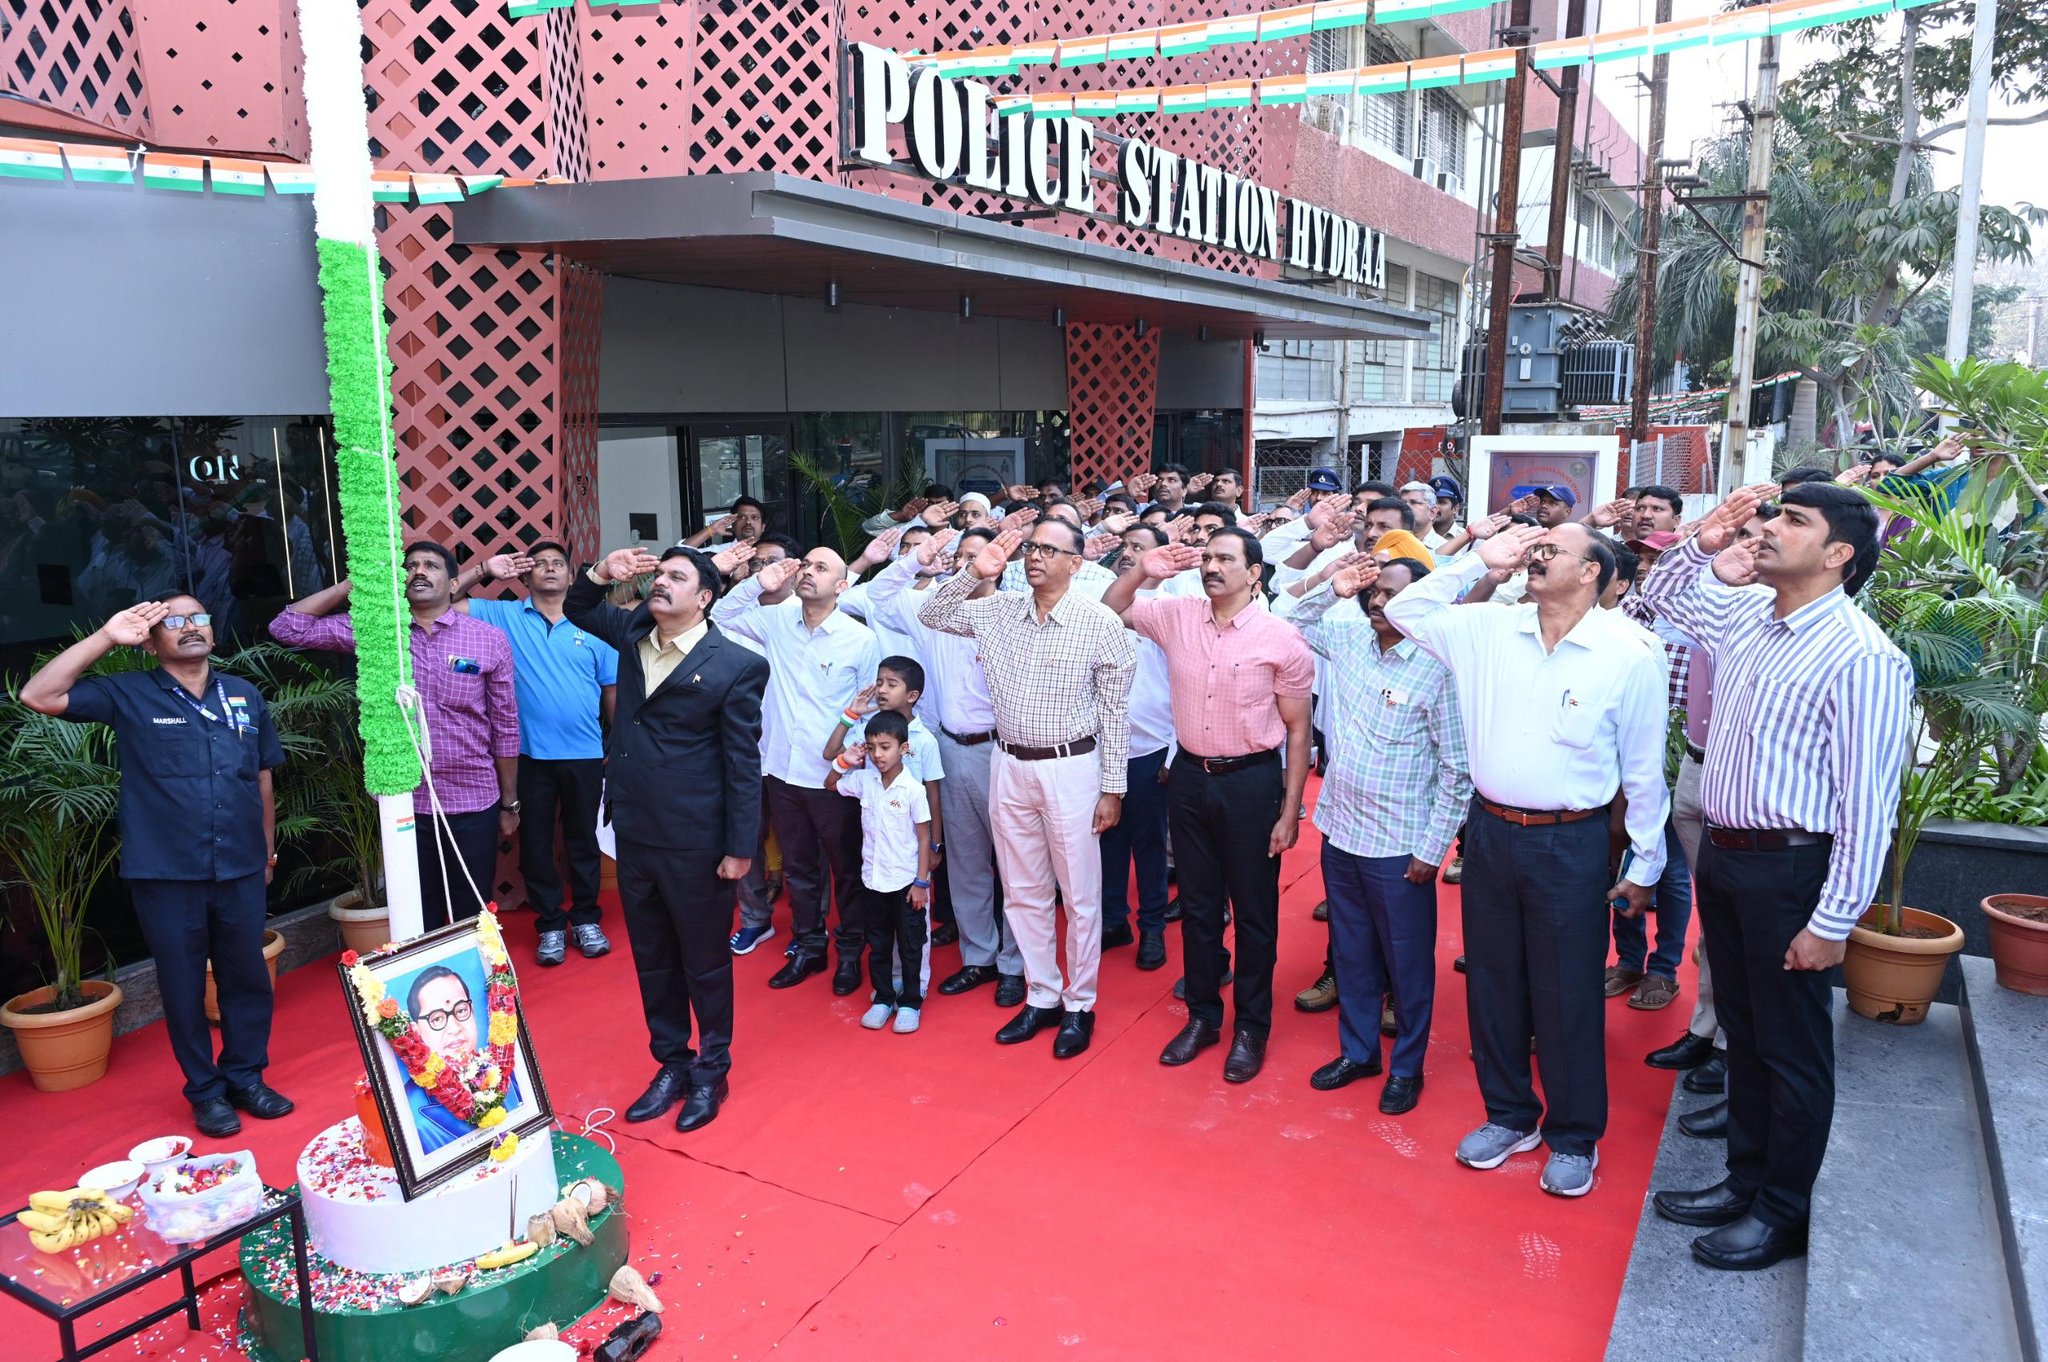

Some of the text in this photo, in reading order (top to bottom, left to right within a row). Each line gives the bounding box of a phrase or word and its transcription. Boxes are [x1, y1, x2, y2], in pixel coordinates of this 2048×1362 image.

[850, 41, 1386, 289] POLICE STATION HYDRAA
